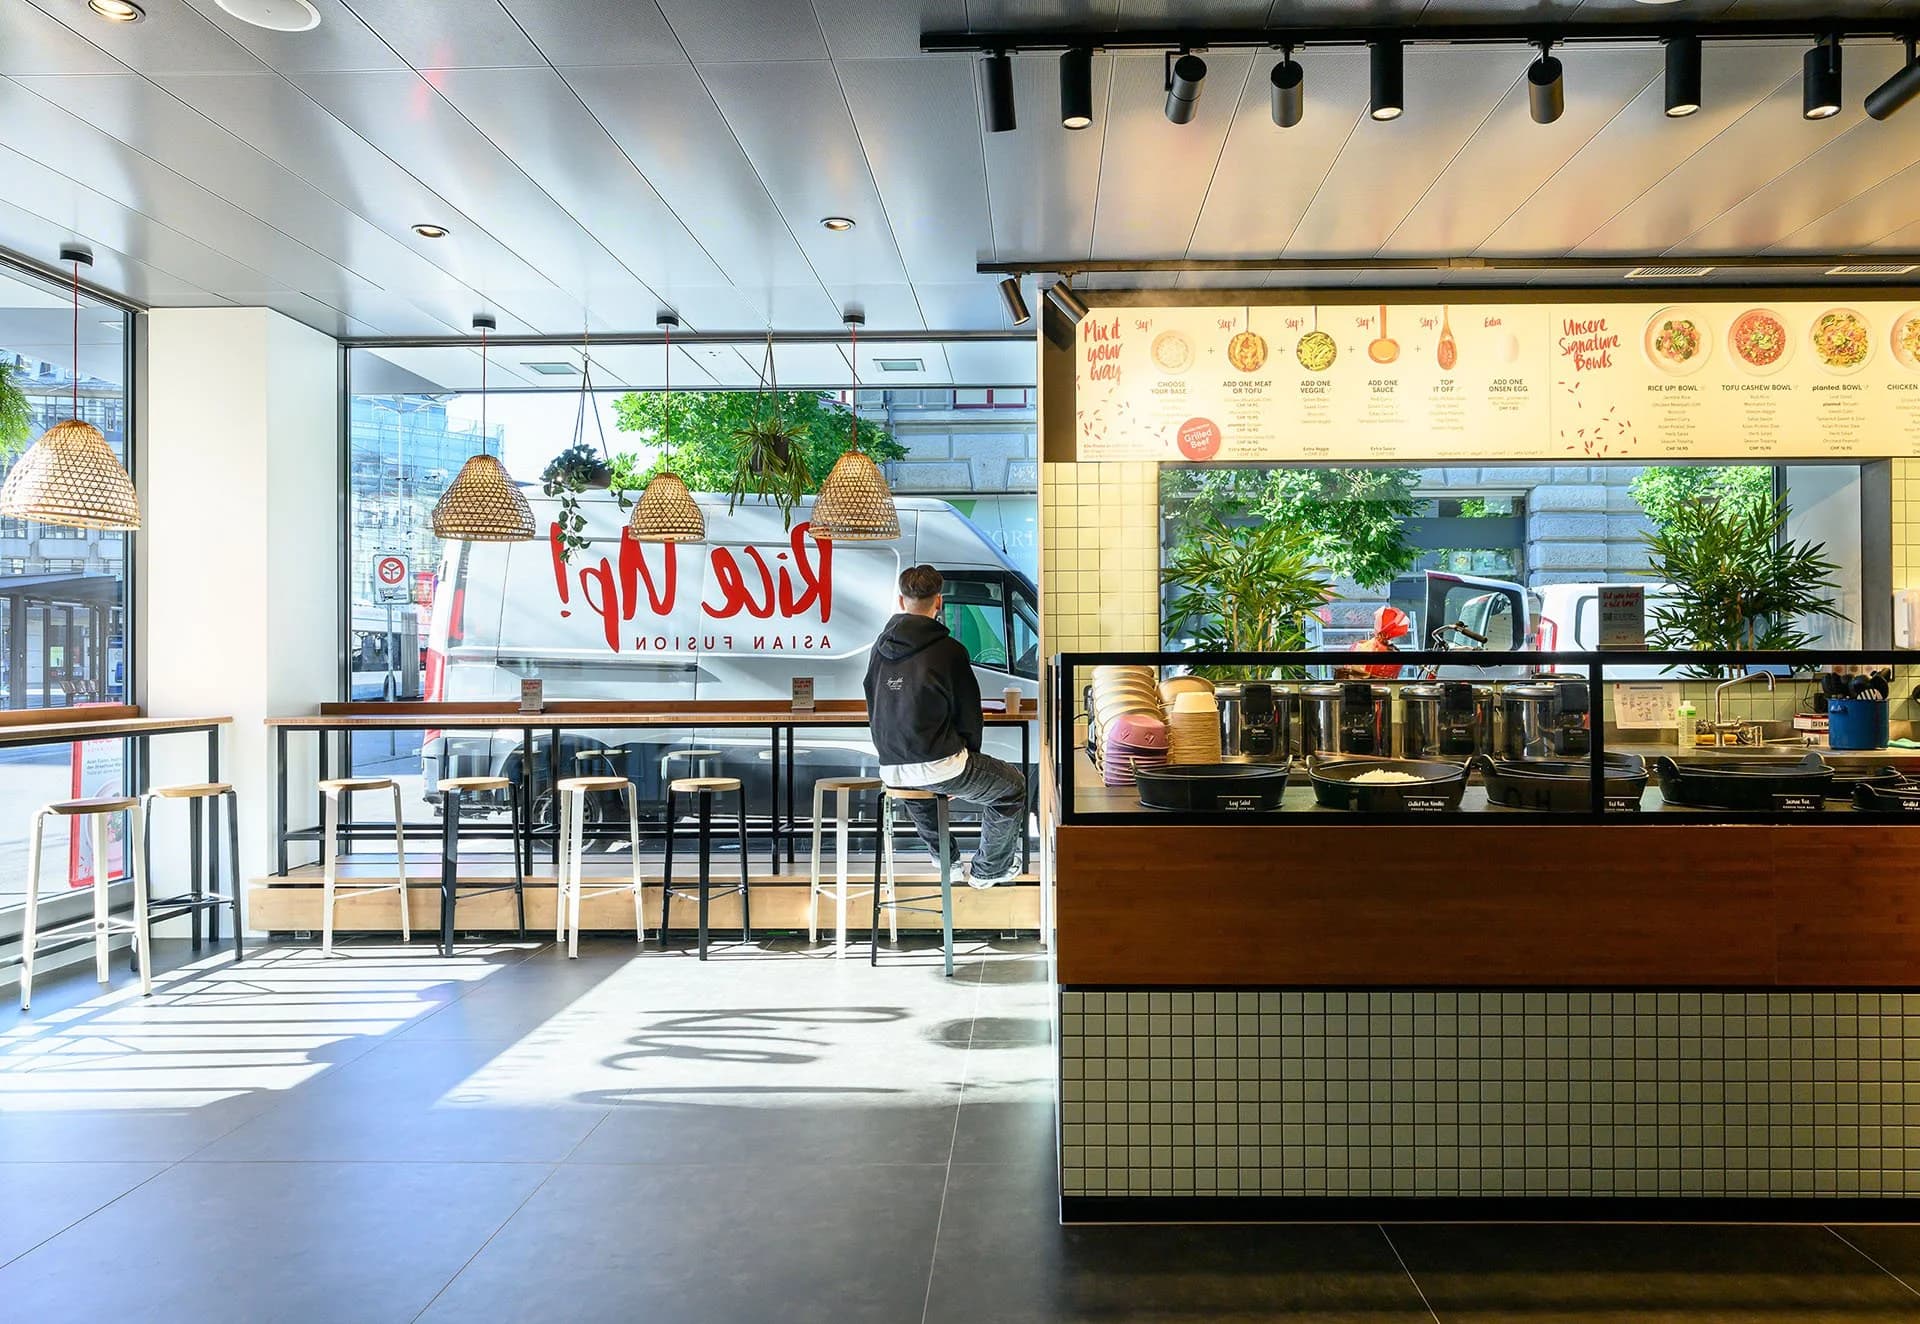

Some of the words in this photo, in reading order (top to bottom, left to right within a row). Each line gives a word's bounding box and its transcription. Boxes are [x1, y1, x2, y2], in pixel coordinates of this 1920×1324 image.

[1217, 318, 1232, 331] Step
[1285, 318, 1299, 330] Step
[1355, 317, 1370, 329] Step
[1419, 317, 1433, 330] Step
[1484, 316, 1502, 328] Extra
[1563, 318, 1608, 336] Unsere
[1084, 319, 1109, 342] Mix
[1110, 317, 1121, 340] it
[1558, 334, 1621, 356] Signature
[1087, 343, 1124, 366] your
[1574, 352, 1612, 371] Bowls
[1090, 362, 1122, 385] way
[1254, 380, 1272, 388] MEAT
[1648, 384, 1664, 392] RICE
[1665, 384, 1677, 392] UP!
[1678, 384, 1698, 392] BOWL
[1184, 428, 1213, 442] Grilled
[1191, 437, 1210, 448] Beef
